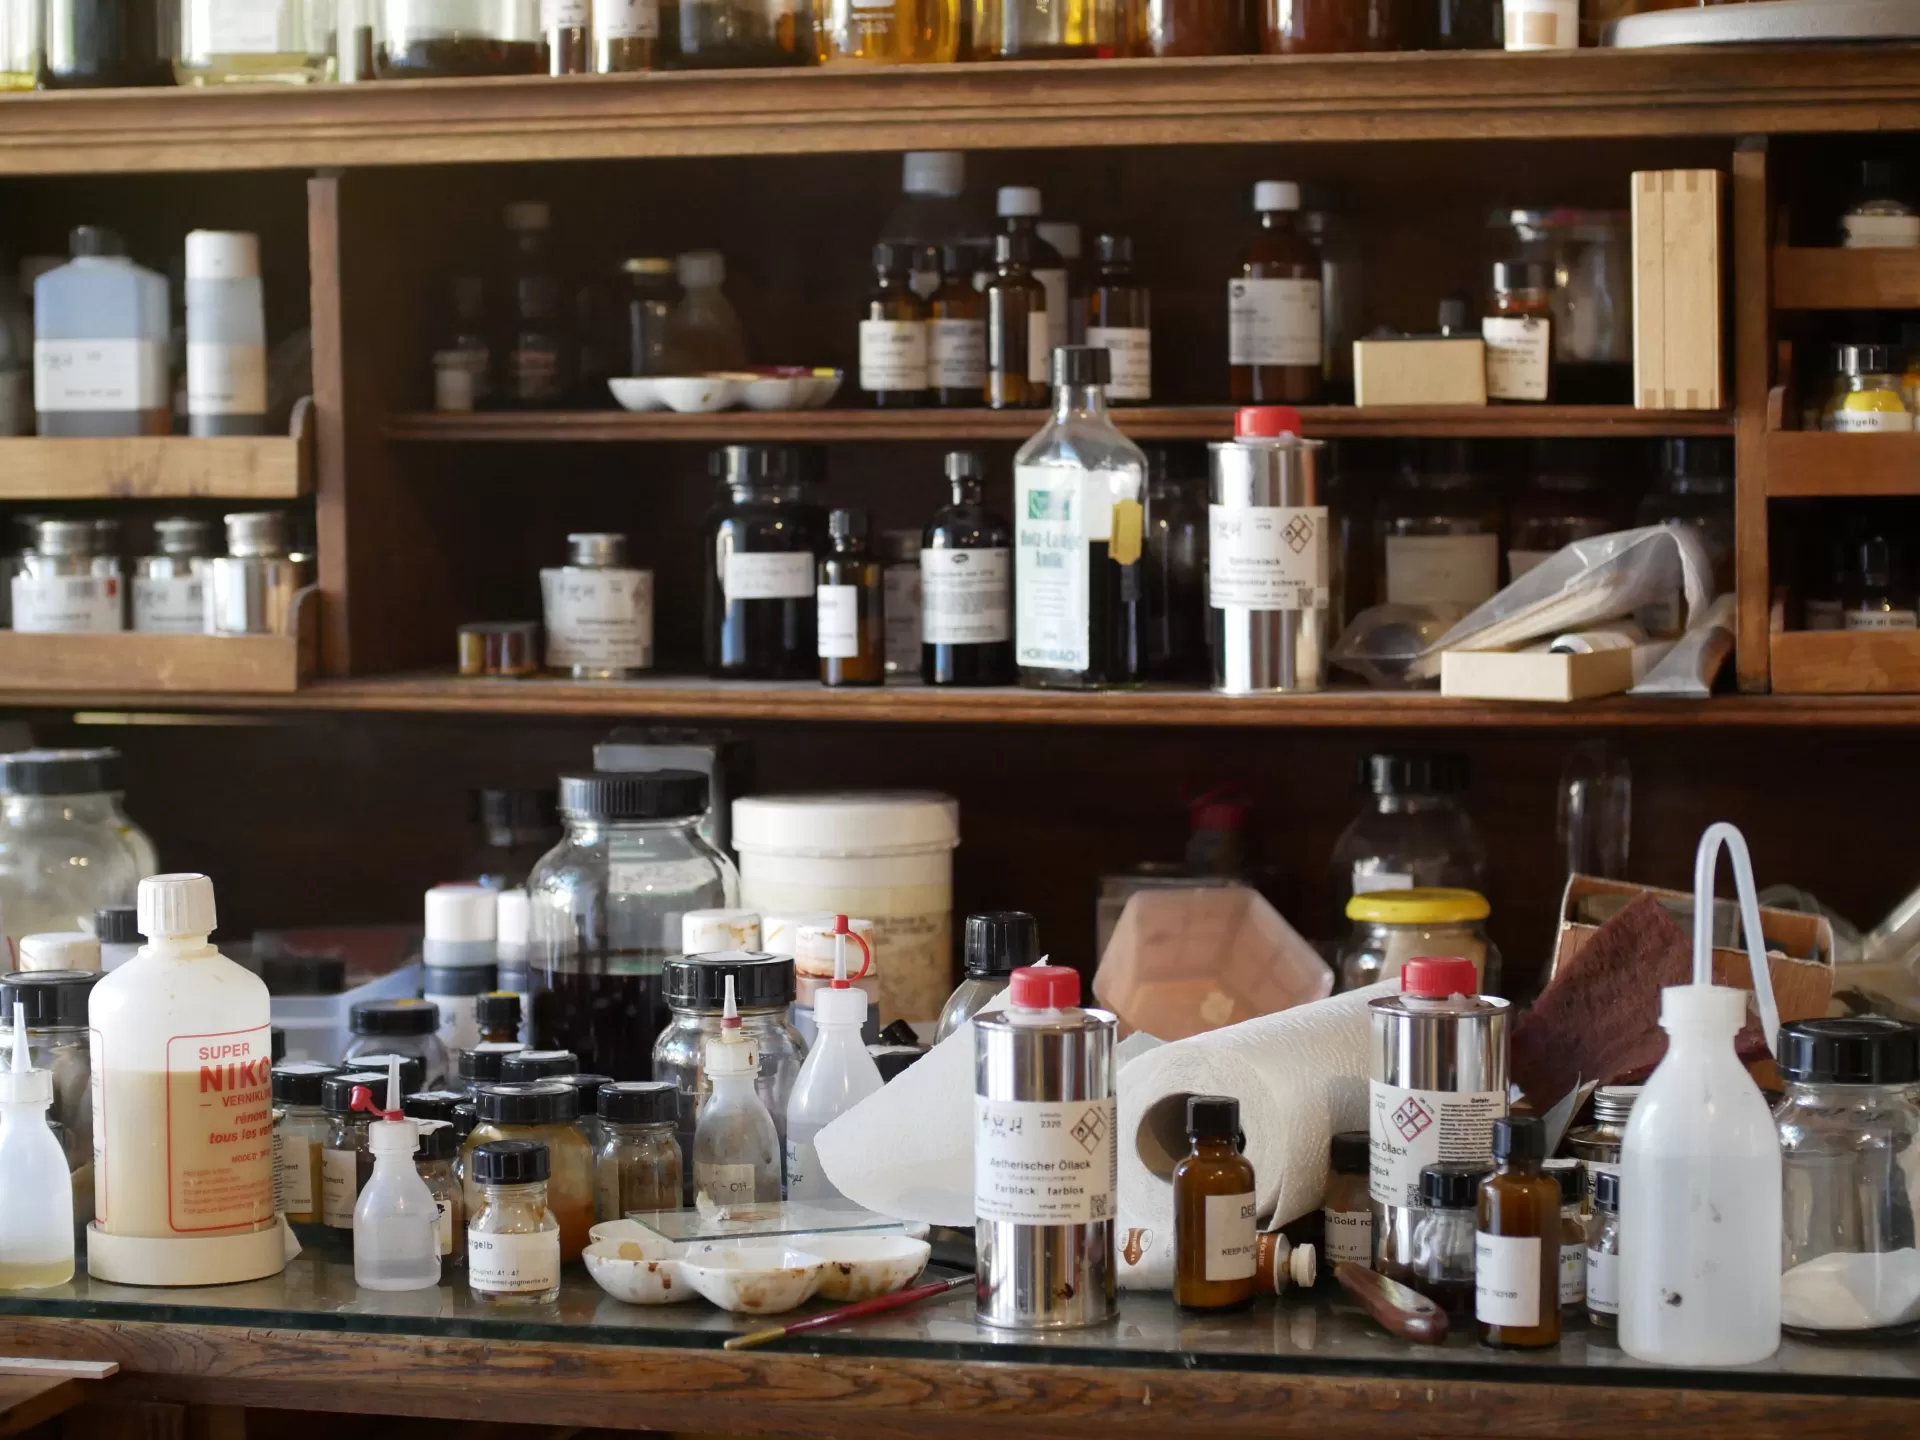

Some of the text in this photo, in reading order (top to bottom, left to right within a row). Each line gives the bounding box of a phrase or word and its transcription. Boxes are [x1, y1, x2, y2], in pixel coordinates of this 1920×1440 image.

[199, 1043, 250, 1061] SUPER
[209, 1131, 238, 1145] tous
[242, 1128, 257, 1140] les
[990, 1159, 1091, 1171] Aetherischer Öllack
[1047, 1186, 1084, 1196] farblos
[1334, 1217, 1357, 1226] Gold
[1221, 1247, 1241, 1256] KEEP
